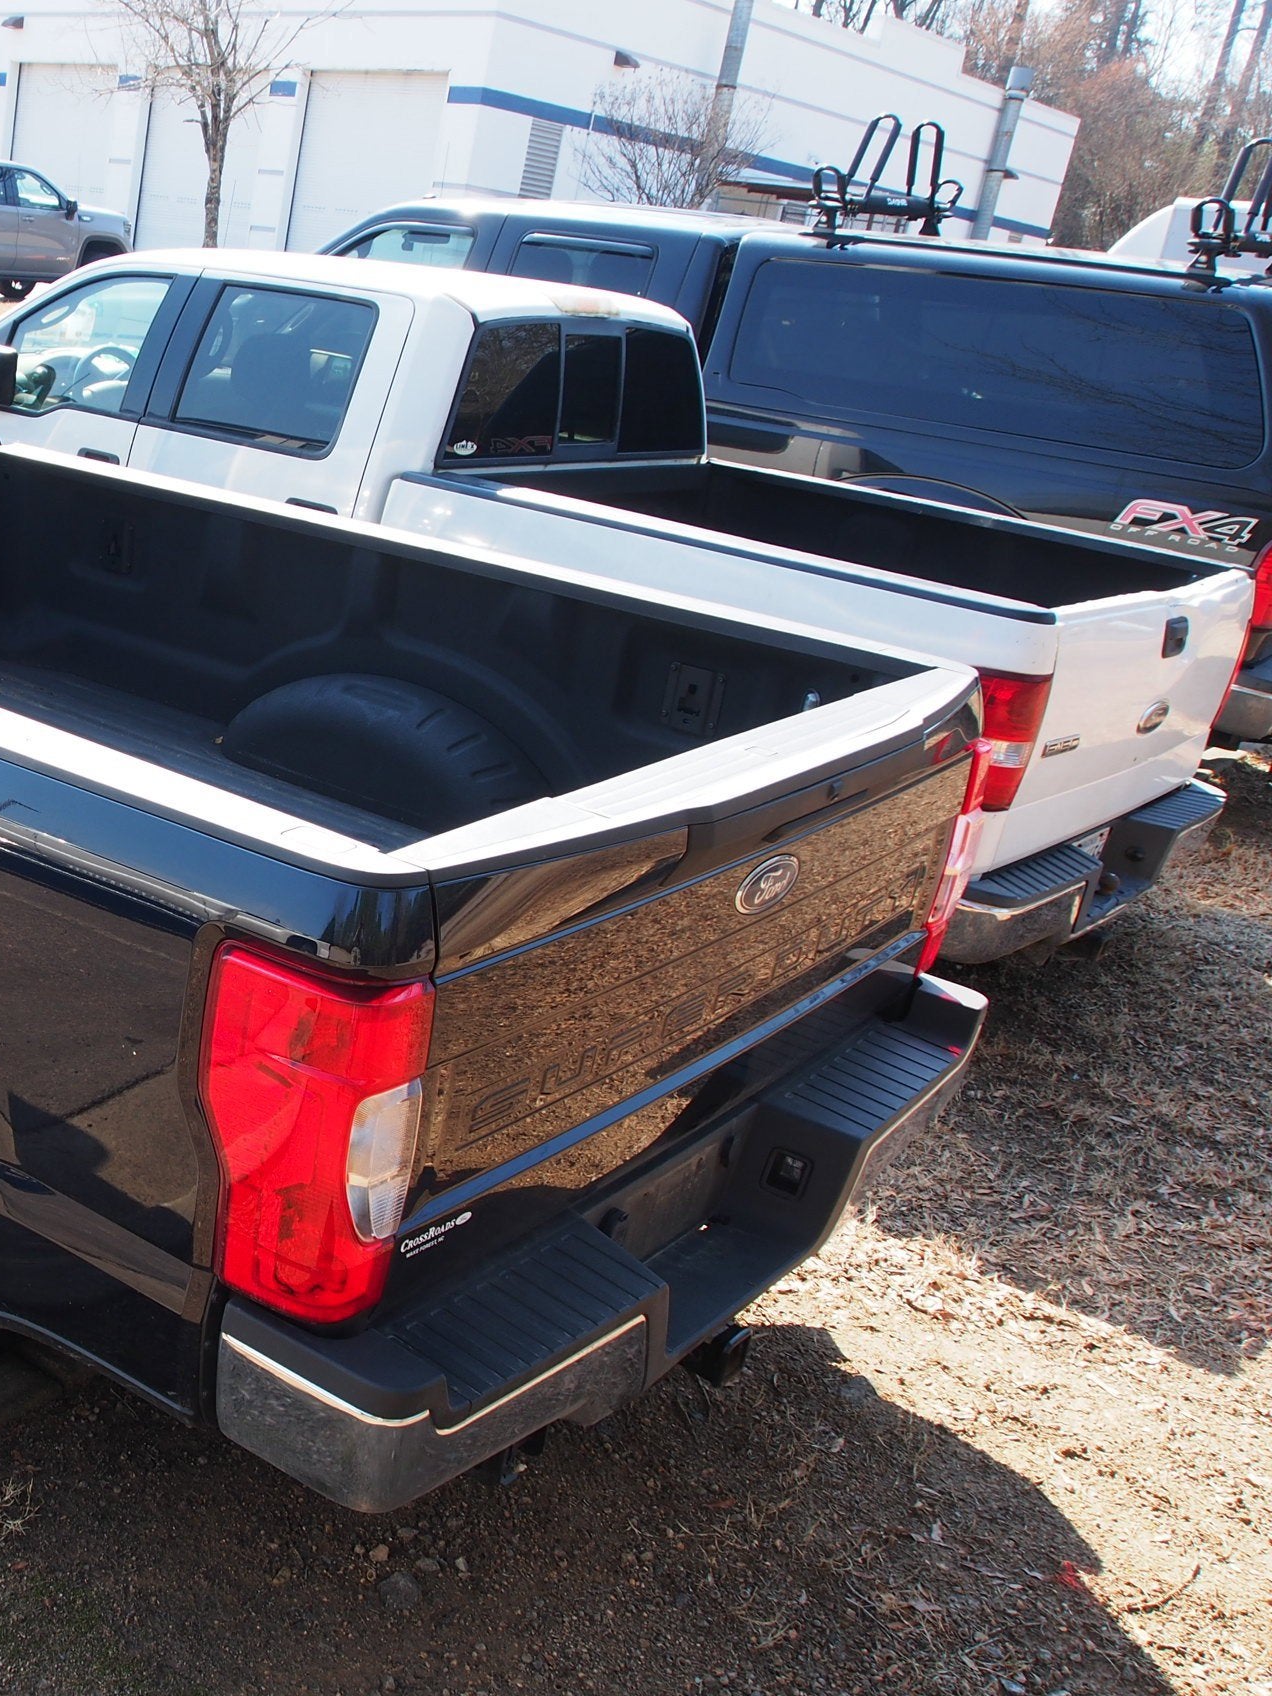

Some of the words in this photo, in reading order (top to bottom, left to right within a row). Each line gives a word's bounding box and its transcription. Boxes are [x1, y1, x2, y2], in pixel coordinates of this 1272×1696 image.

[1109, 523, 1159, 536] OFF
[1167, 534, 1239, 553] ROAD
[1113, 498, 1260, 546] FX4
[754, 868, 791, 904] Ford
[469, 970, 755, 1134] SUPER
